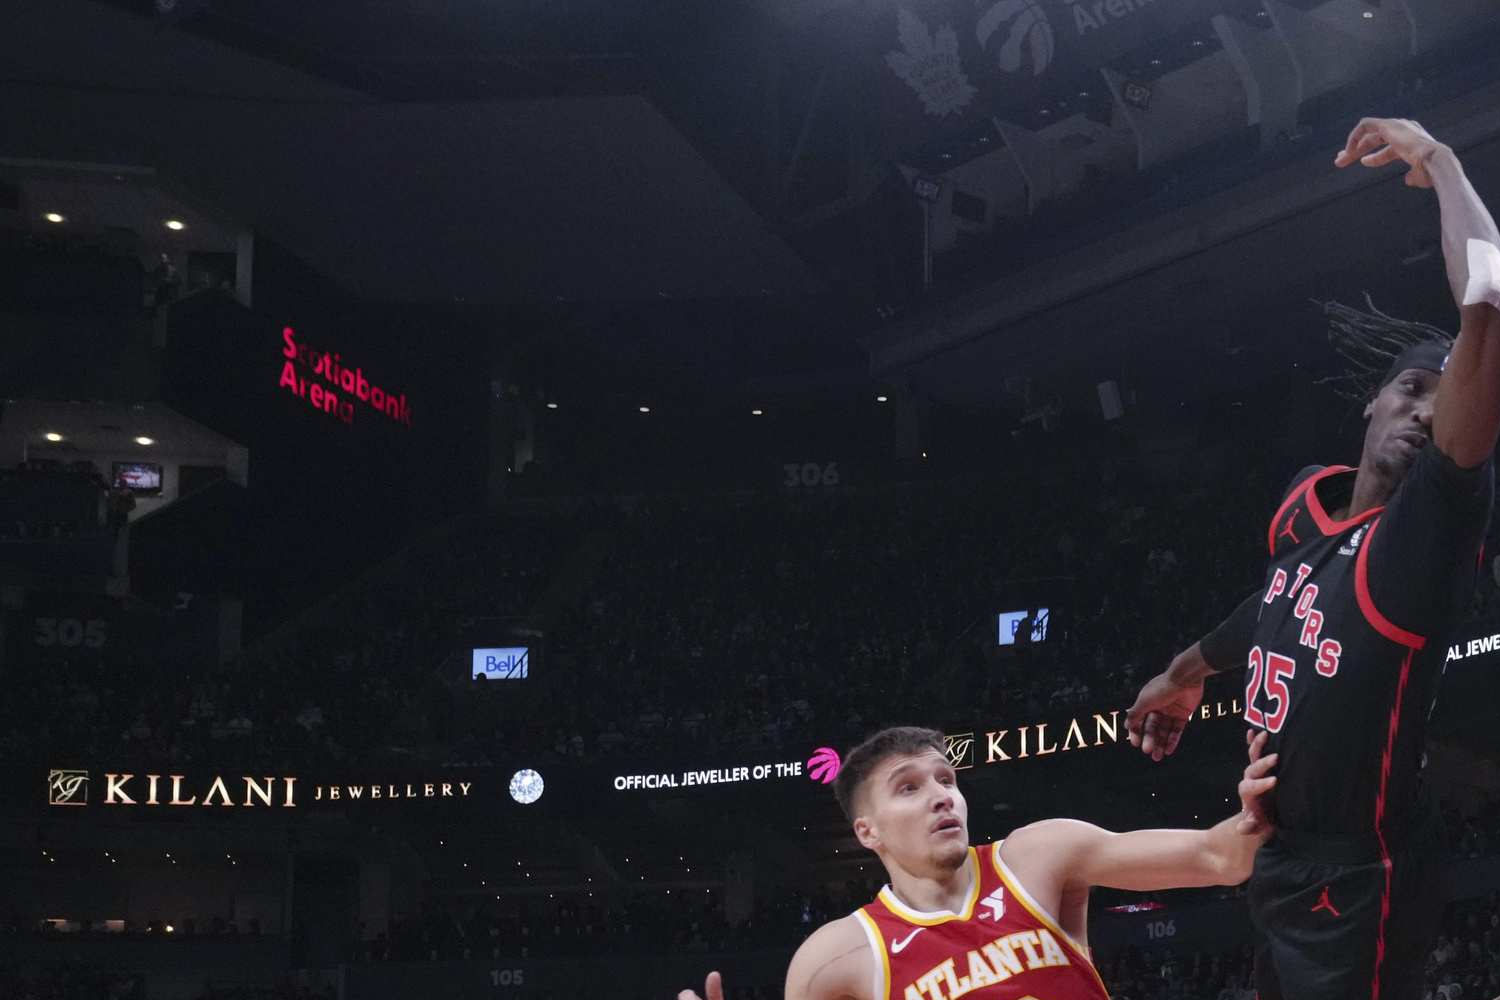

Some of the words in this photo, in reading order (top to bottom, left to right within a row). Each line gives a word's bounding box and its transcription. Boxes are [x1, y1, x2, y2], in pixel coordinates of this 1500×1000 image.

[1073, 0, 1153, 35] Are
[280, 360, 354, 424] Arena
[282, 326, 412, 426] Scotiabank
[783, 462, 840, 487] 306
[1264, 562, 1342, 678] PTORS
[486, 655, 516, 672] Bell
[1244, 645, 1296, 734] 25
[985, 708, 1131, 763] KILAN
[103, 773, 297, 808] KILANI
[315, 782, 472, 800] JEWELLERY
[614, 774, 678, 790] OFFICIAL
[681, 767, 749, 787] JEWELLER
[752, 764, 772, 780] OF
[775, 762, 802, 777] THE
[1146, 920, 1177, 939] 106
[490, 970, 524, 986] 105
